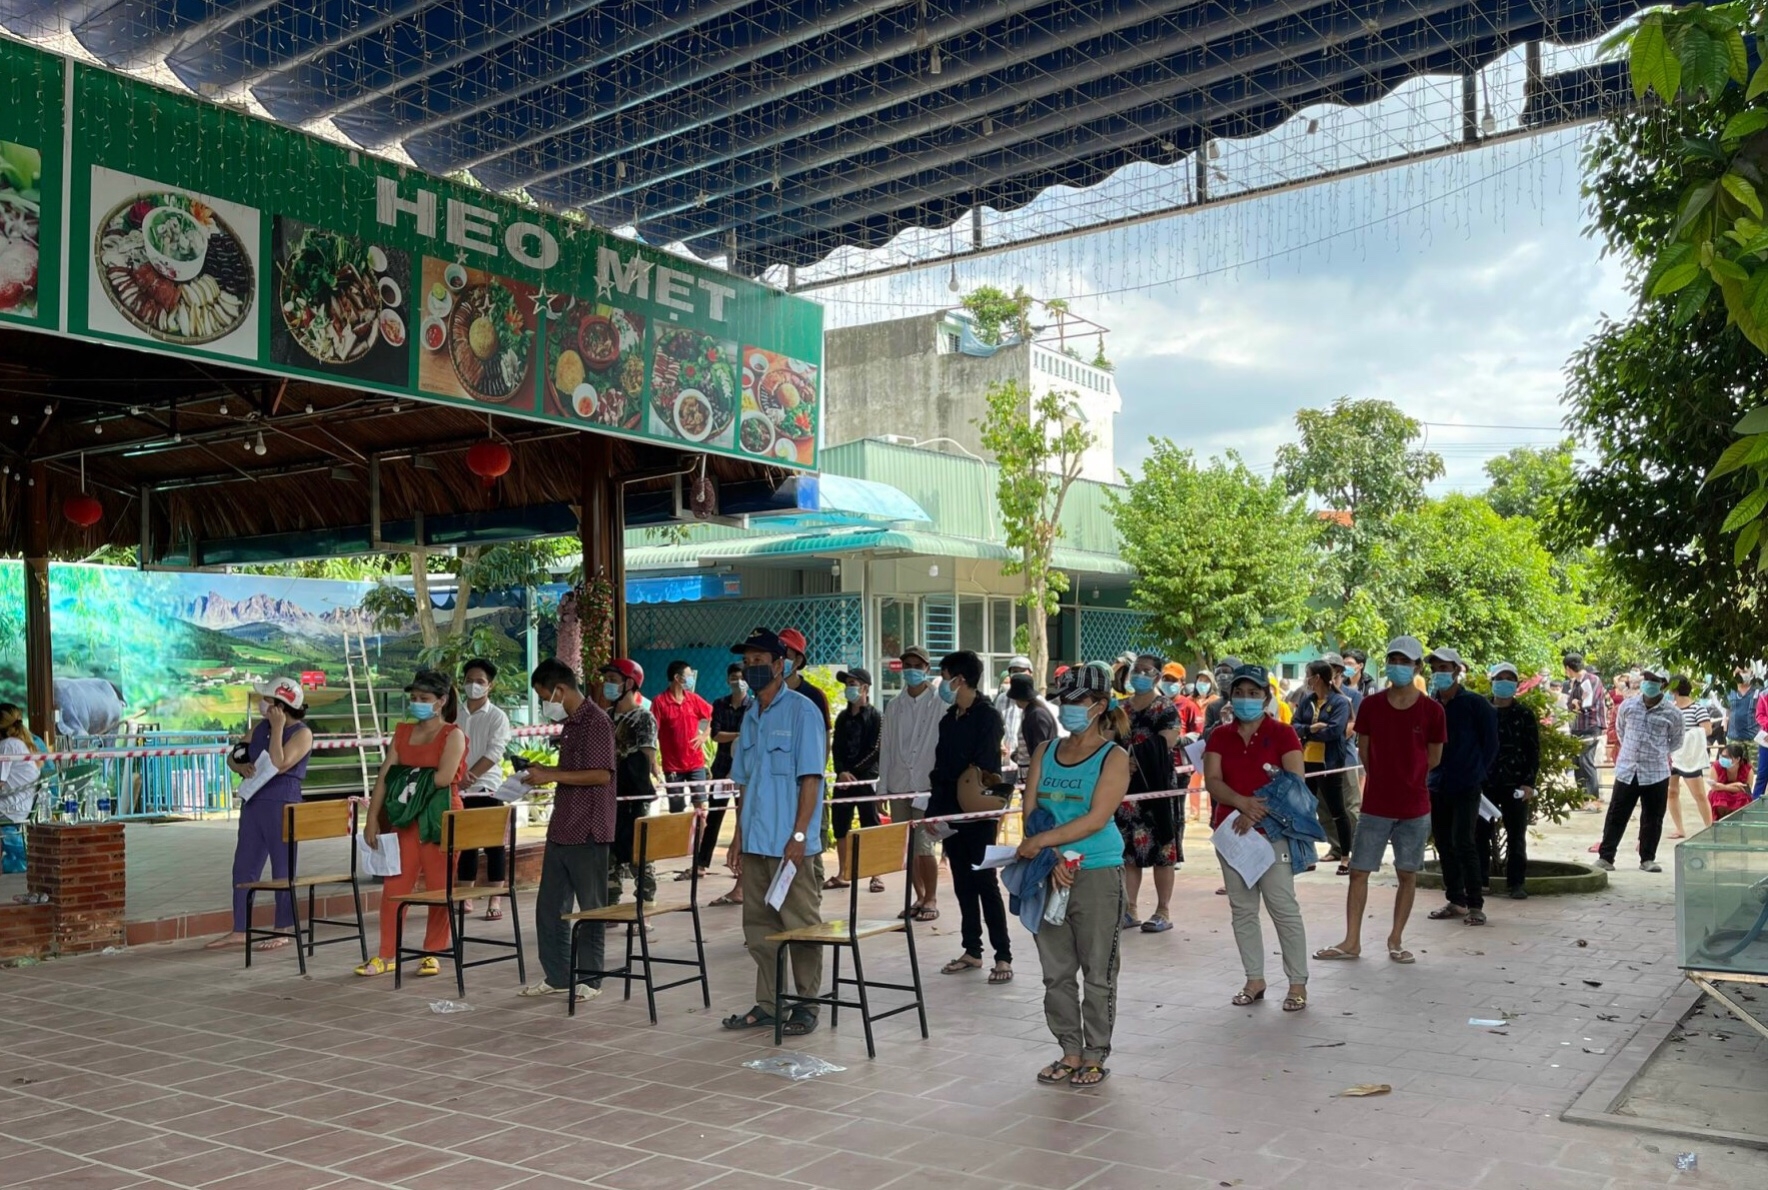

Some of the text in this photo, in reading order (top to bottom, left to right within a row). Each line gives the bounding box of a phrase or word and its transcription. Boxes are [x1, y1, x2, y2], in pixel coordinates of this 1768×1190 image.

[376, 175, 736, 321] HEO MẸT
[1043, 777, 1082, 789] GUCCI
